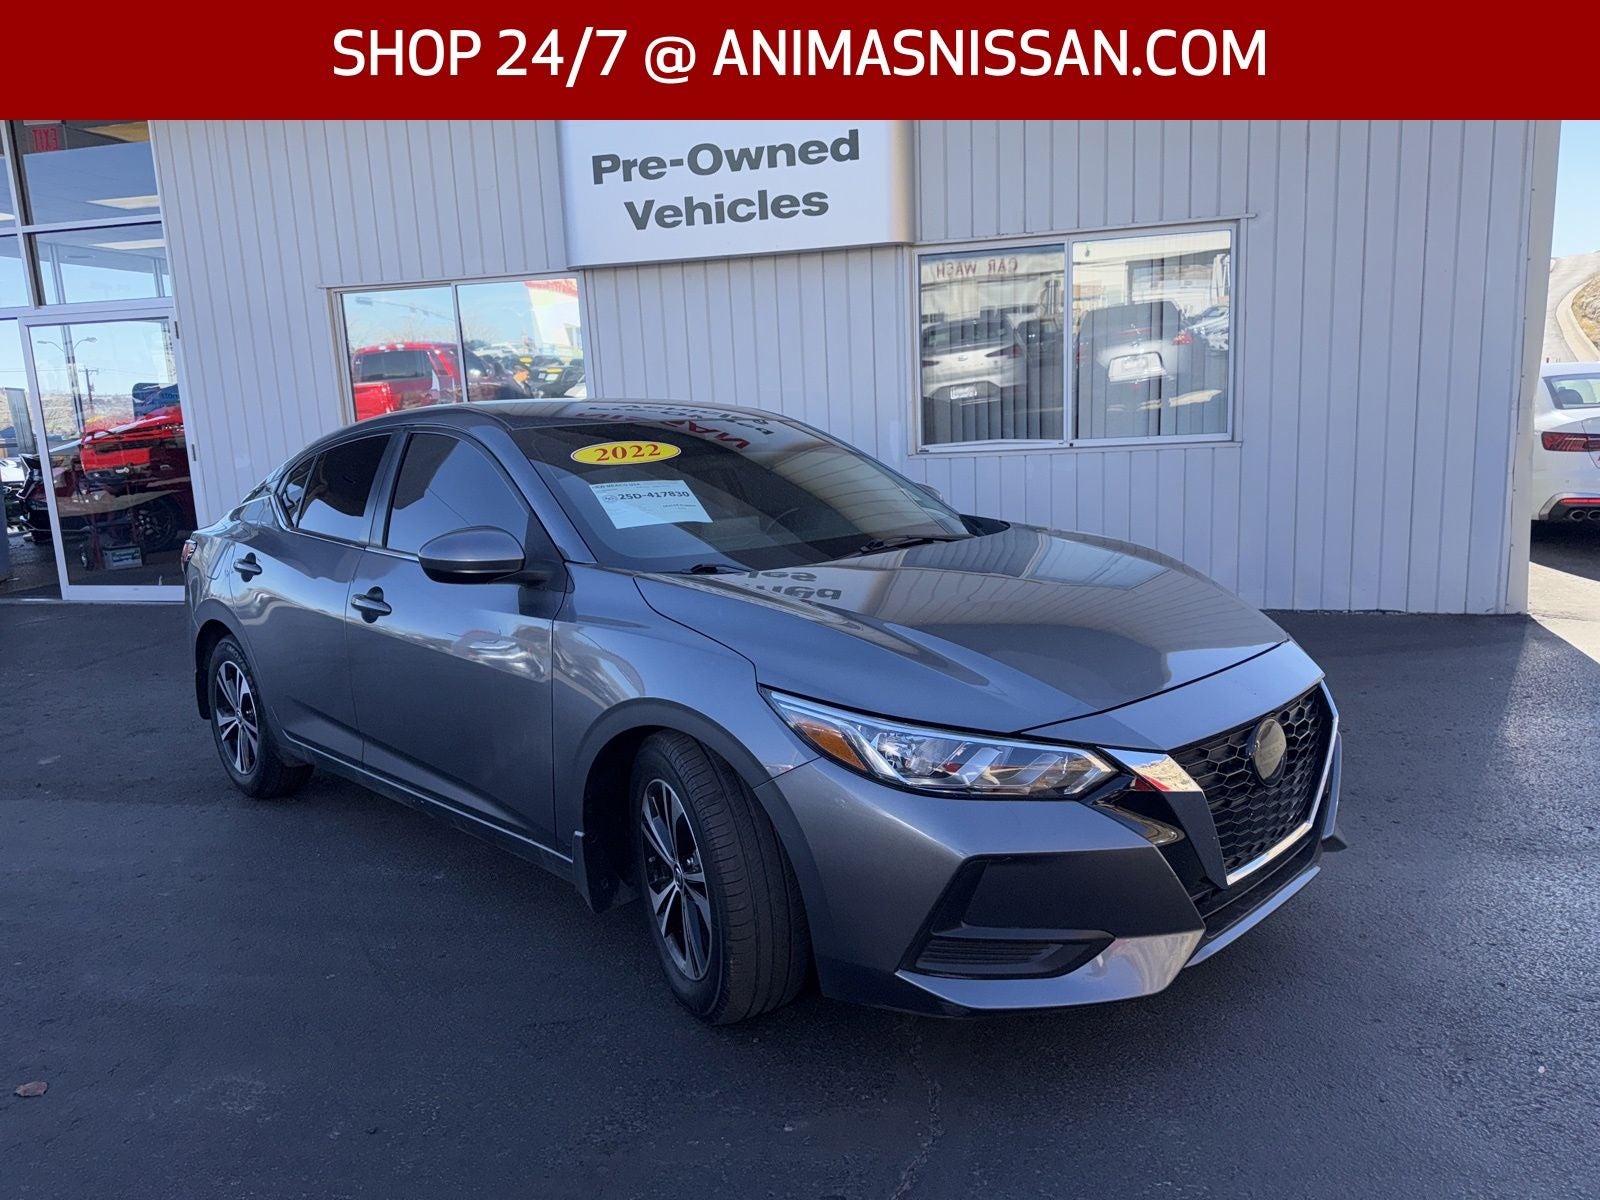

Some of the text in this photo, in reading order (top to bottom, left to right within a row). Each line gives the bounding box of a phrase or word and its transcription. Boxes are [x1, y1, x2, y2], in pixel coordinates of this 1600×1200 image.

[591, 128, 860, 185] Pre-Owned
[623, 189, 830, 231] Vehicles
[593, 443, 662, 462] 2022
[618, 489, 690, 501] 25D-417830
